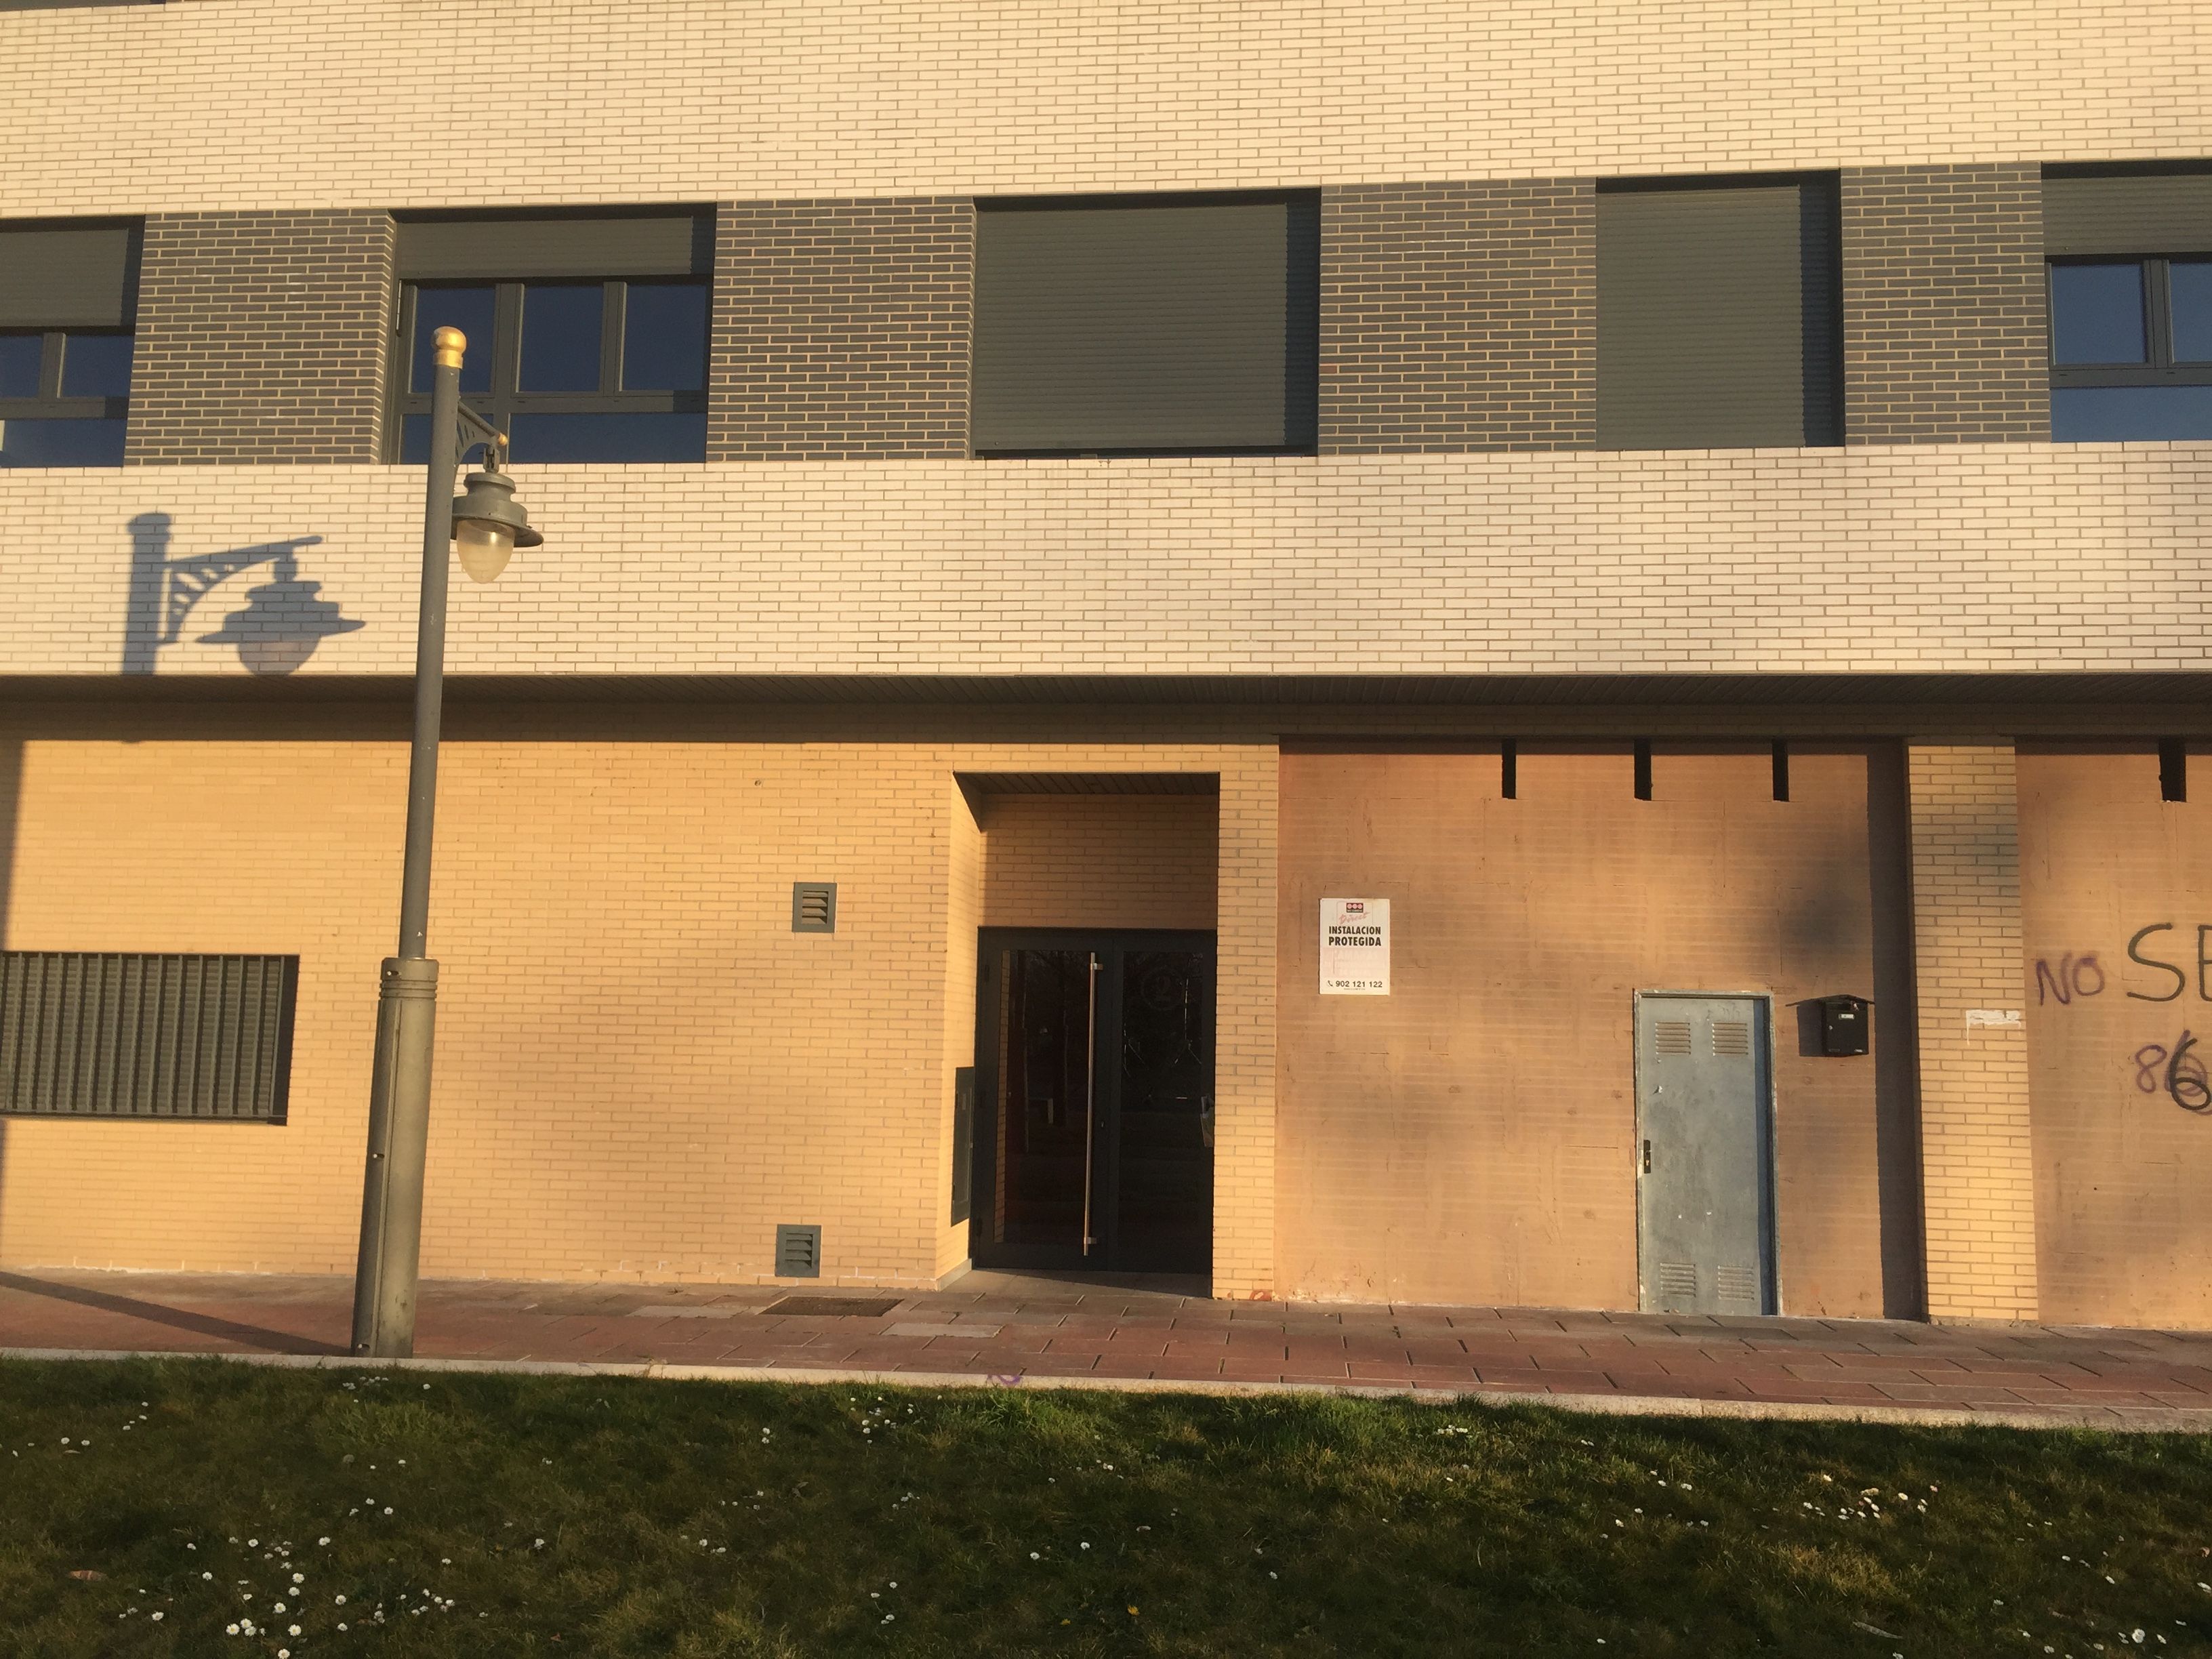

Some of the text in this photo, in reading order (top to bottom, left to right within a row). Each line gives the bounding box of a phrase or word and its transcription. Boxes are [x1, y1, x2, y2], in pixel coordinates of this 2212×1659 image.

[1329, 926, 1381, 935] INSTALACION
[1328, 937, 1381, 946] PROTEGIDA
[2035, 951, 2105, 1006] NO
